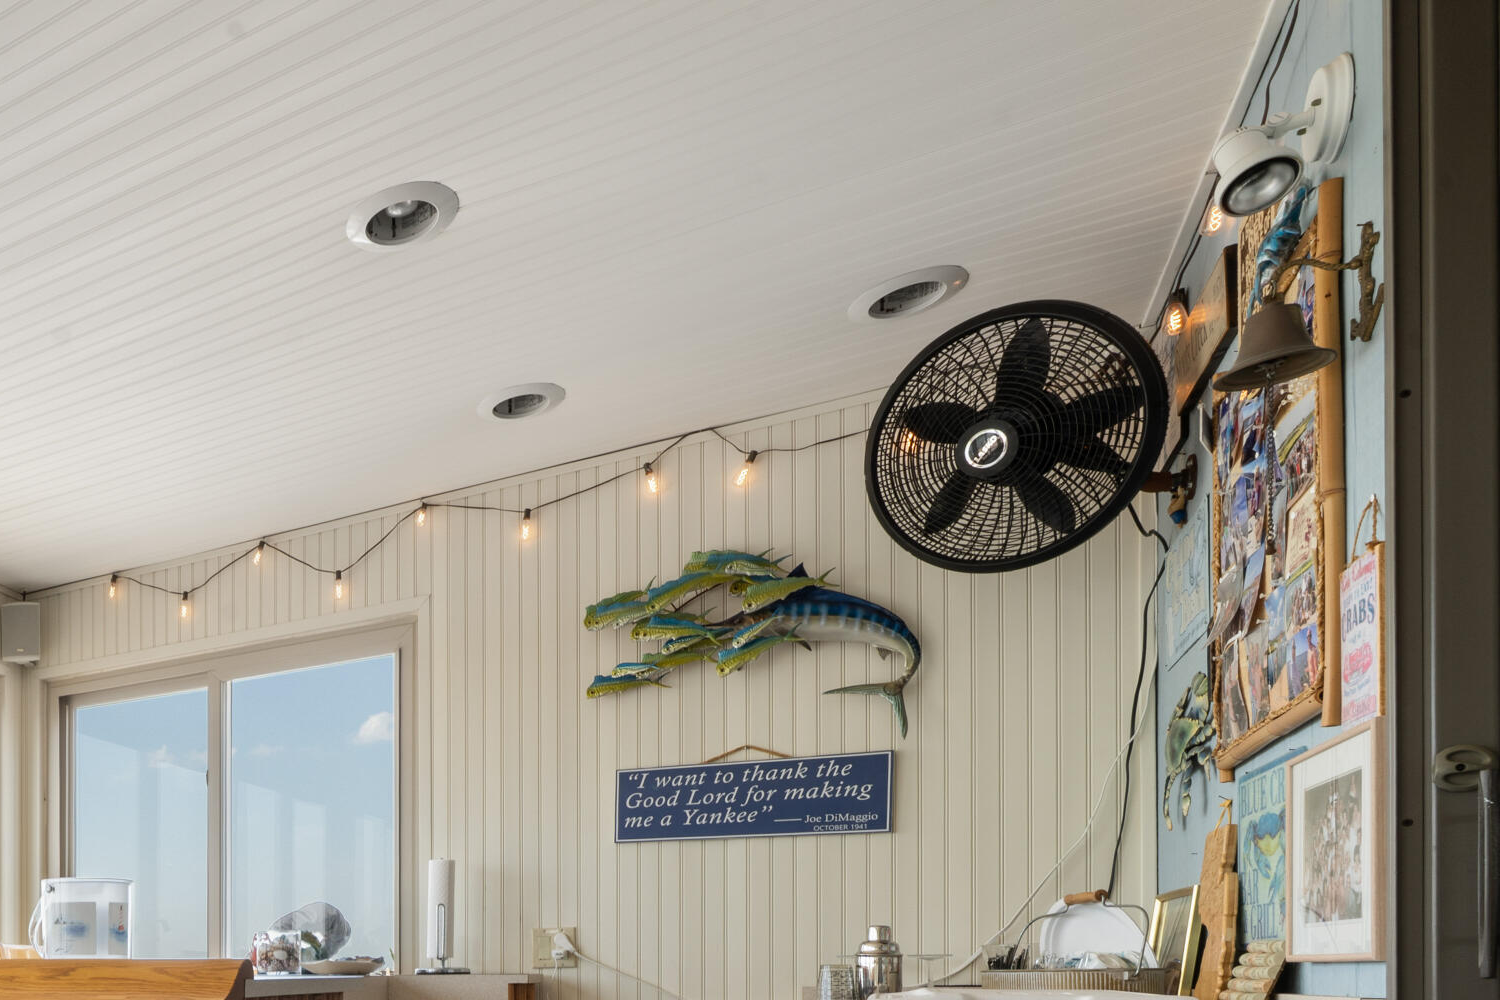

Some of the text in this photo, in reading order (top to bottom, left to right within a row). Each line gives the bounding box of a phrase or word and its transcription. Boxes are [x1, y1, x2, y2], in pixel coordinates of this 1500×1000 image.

[1342, 593, 1375, 641] CRABS
[655, 771, 707, 788] want
[714, 770, 734, 784] to
[742, 762, 808, 783] thank
[816, 760, 853, 778] the
[626, 780, 873, 809] Good Lord for making
[1240, 767, 1286, 818] BLUE CR
[624, 815, 654, 828] me
[660, 814, 672, 827] a
[804, 812, 879, 824] Joe DiMaggio
[1241, 869, 1259, 905] BAR
[1250, 902, 1278, 940] GRILL
